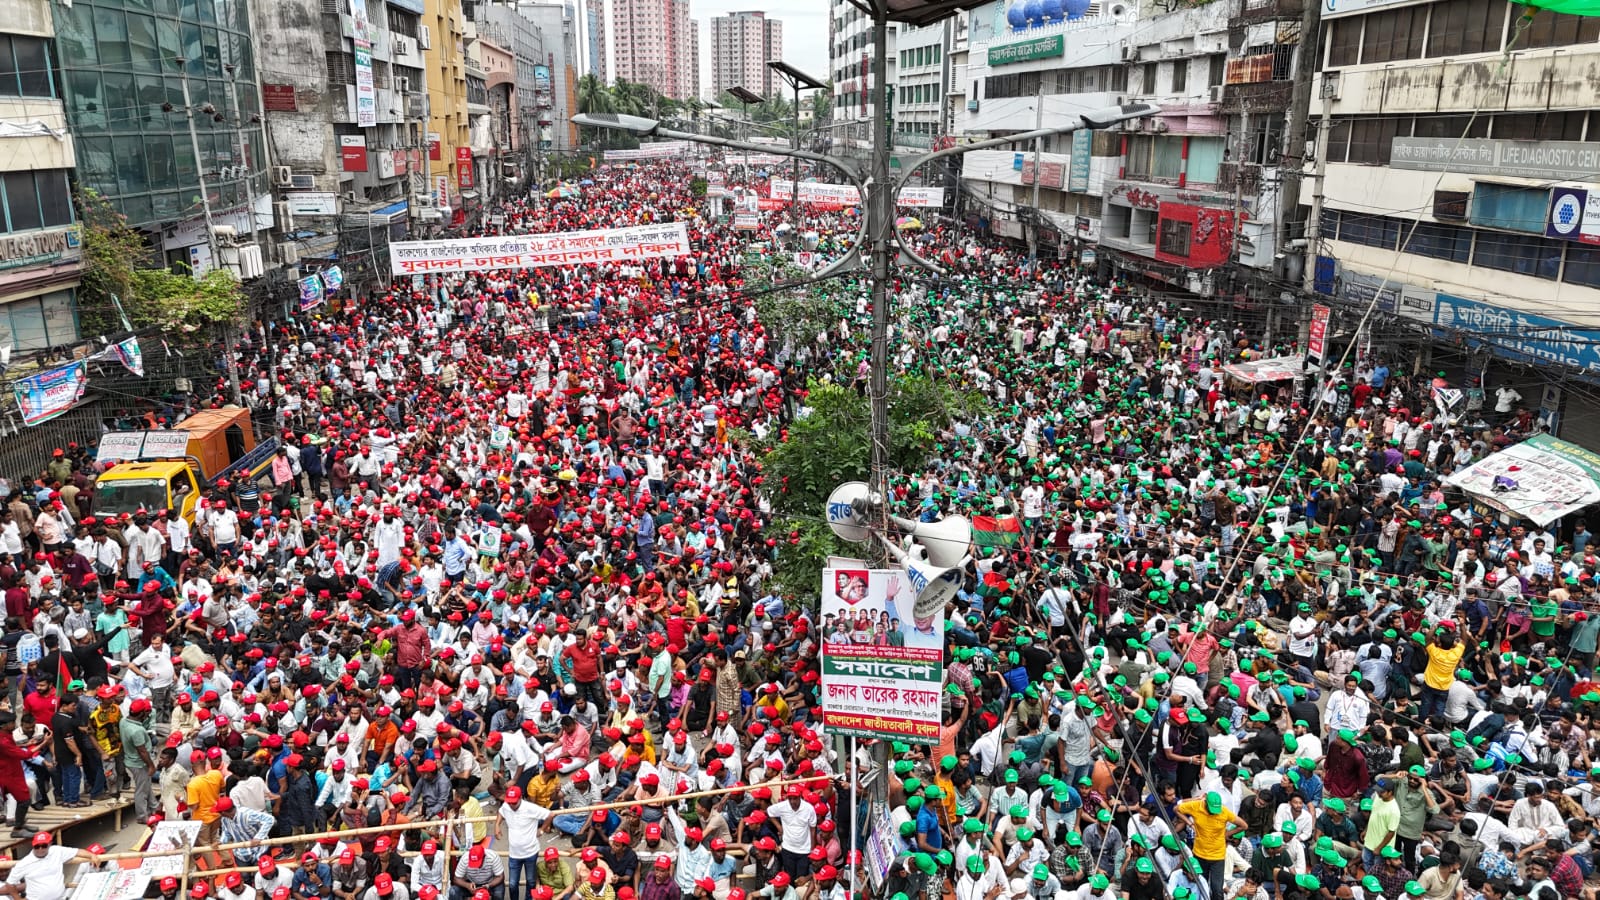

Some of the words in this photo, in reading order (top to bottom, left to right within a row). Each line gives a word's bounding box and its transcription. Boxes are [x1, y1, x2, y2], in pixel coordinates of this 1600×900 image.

[1502, 147, 1520, 163] LIFE
[1521, 147, 1575, 167] DIAGNOSTIC
[439, 178, 448, 207] Bata
[34, 232, 65, 254] TOURS
[396, 246, 428, 258] তারুণ্যের
[430, 243, 467, 257] রাজনৈতিক
[469, 242, 497, 254] অধিকার
[499, 240, 528, 253] প্রতিষ্ঠায়
[530, 240, 543, 252] ২৮
[568, 235, 605, 249] সমাবেশে
[607, 235, 623, 247] যোগ
[661, 230, 681, 242] করুন
[529, 248, 613, 264] মহানগর
[622, 242, 682, 257] দক্ষিণ
[1457, 303, 1513, 336] আইসিবি
[1497, 333, 1580, 366] Islamic
[831, 660, 937, 680] সমাবেশ
[973, 655, 985, 671] 96
[826, 683, 858, 700] জনাব
[860, 685, 899, 704] তারেক
[902, 688, 939, 708] রহমান
[826, 714, 862, 727] বাংলাদেশ
[864, 716, 913, 733] জাতীয়তাবাদী
[916, 723, 939, 736] যুবদল
